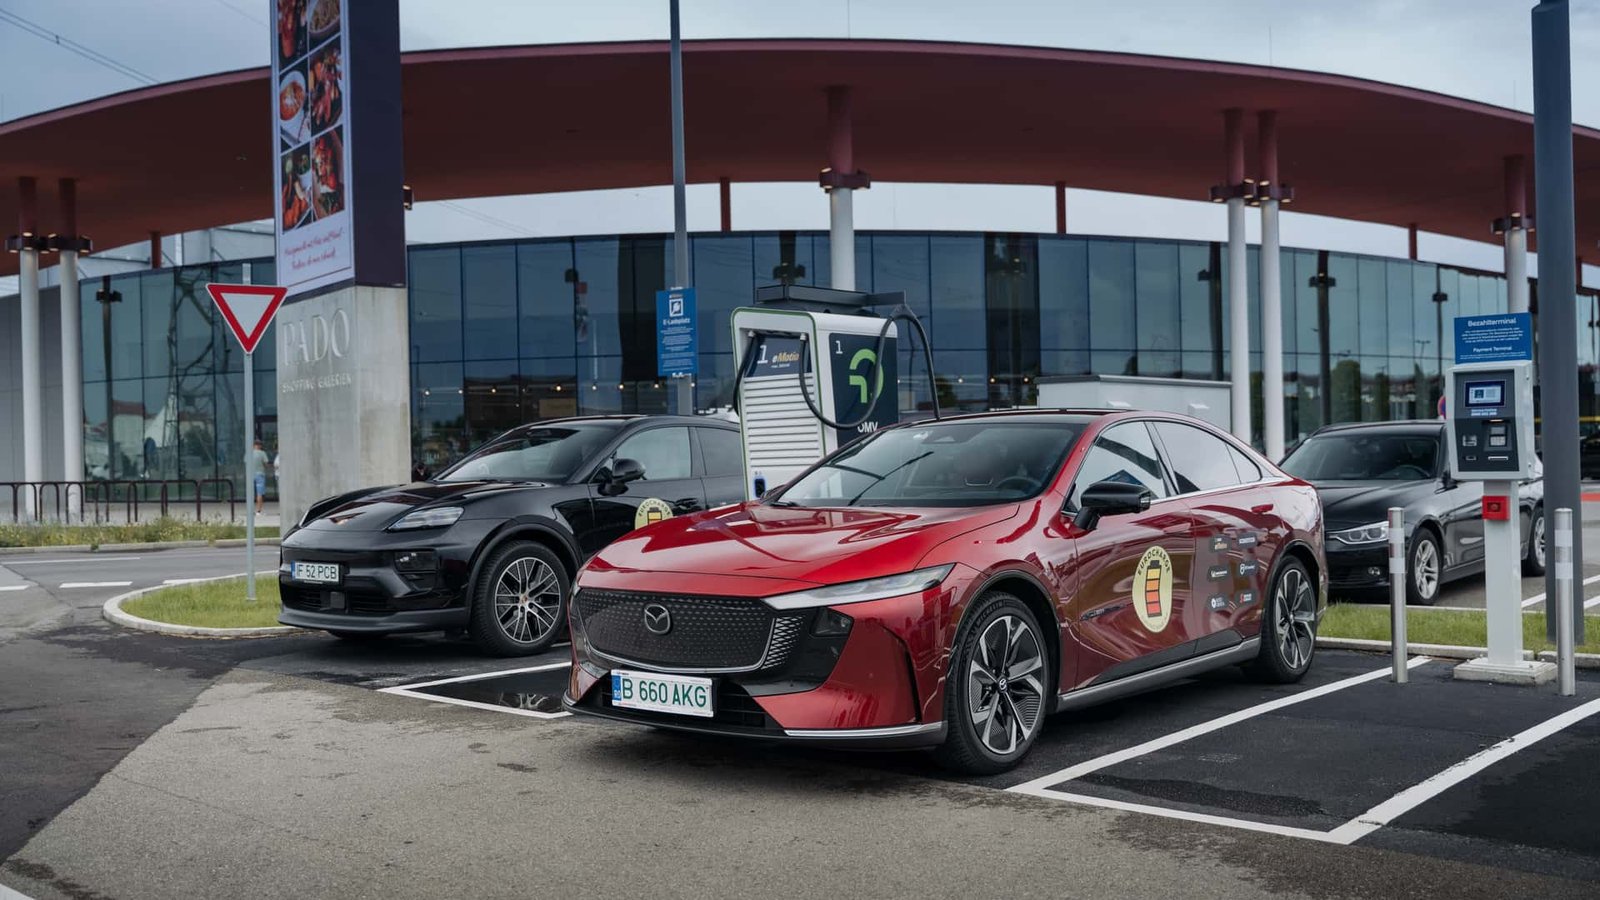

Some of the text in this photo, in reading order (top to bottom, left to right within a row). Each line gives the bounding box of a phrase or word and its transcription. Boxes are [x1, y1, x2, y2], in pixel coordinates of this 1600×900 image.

[1467, 317, 1517, 327] Bezahlterminal
[282, 308, 350, 367] PADO
[756, 344, 769, 365] 1
[836, 340, 844, 355] 1
[772, 351, 800, 363] eMotio
[857, 421, 879, 433] OMV
[306, 564, 316, 578] 52
[317, 565, 337, 580] PCB
[622, 678, 633, 700] B
[639, 680, 668, 704] 660
[672, 683, 707, 708] AKG
